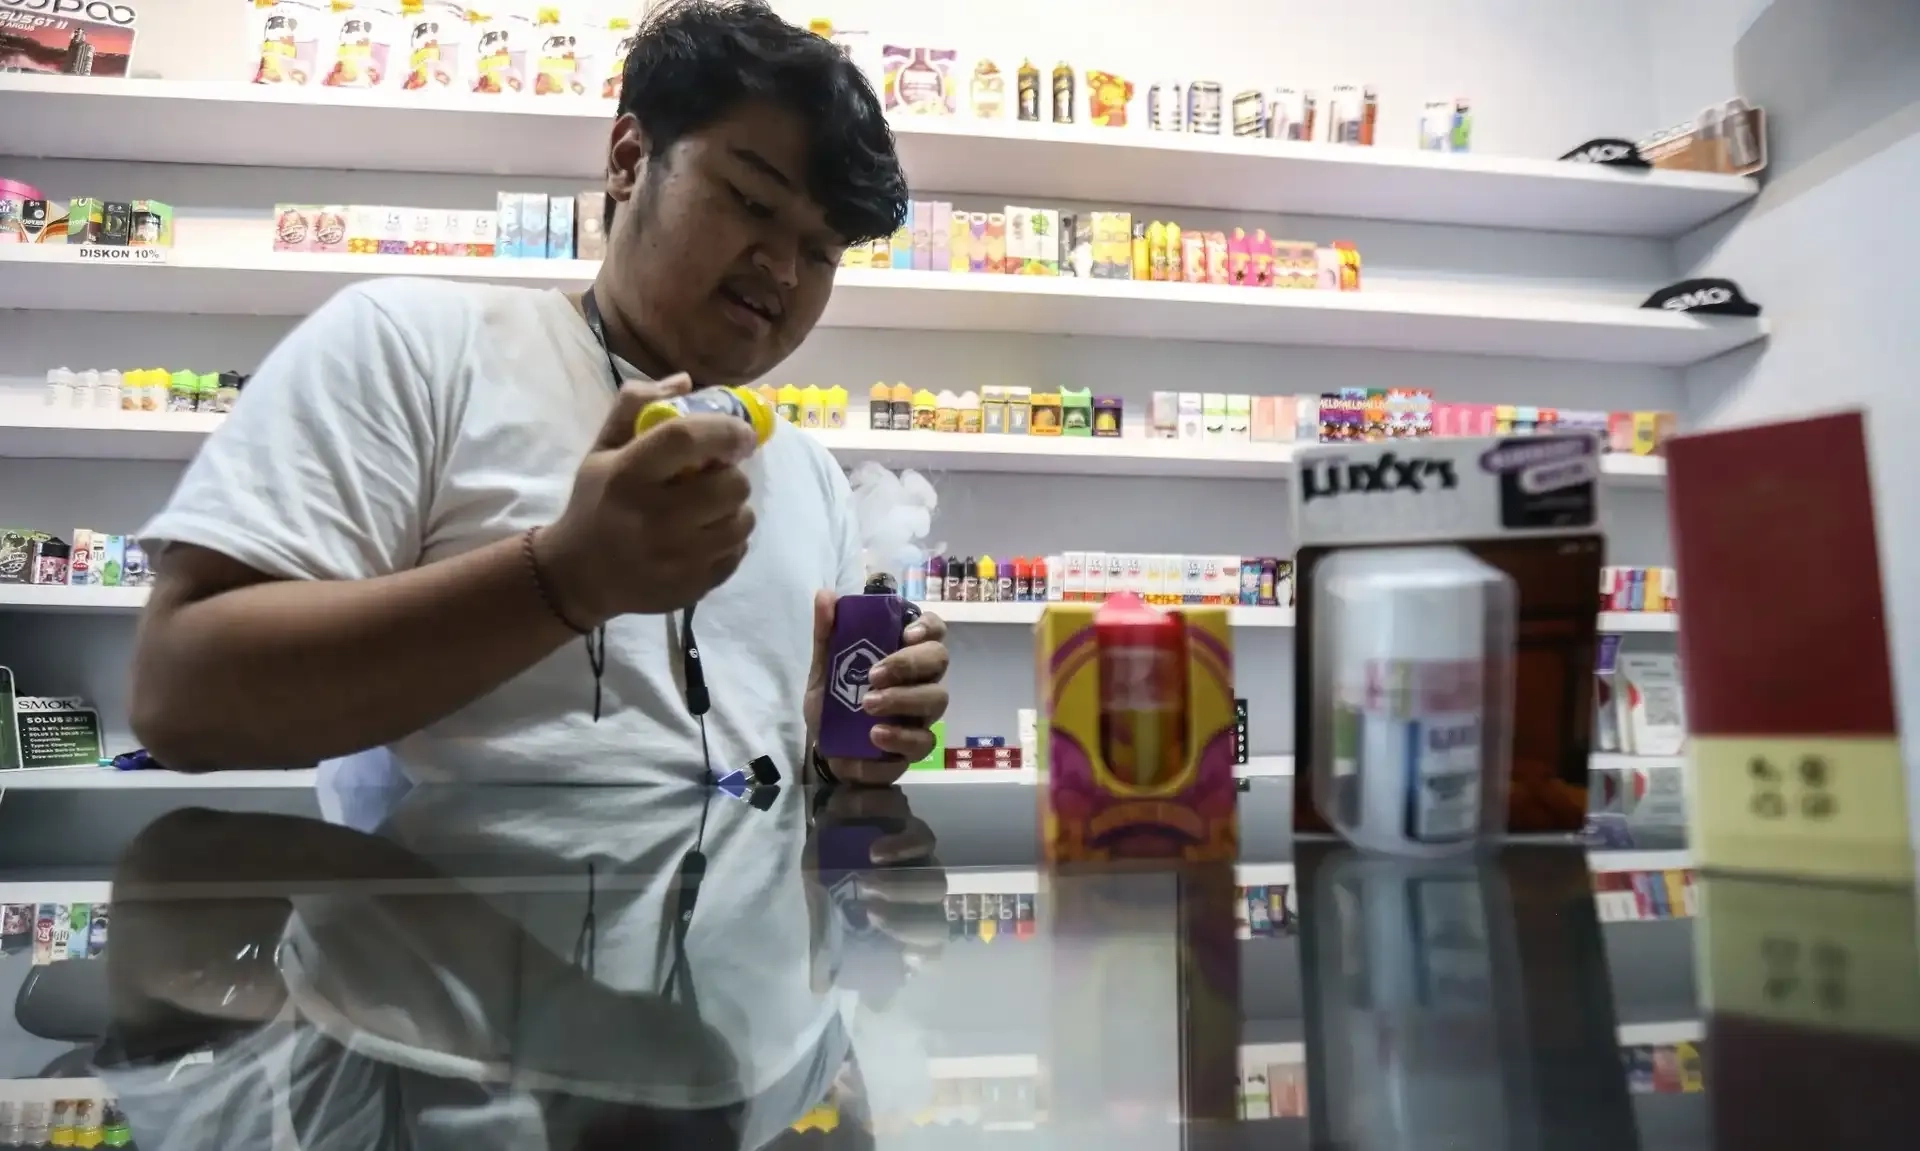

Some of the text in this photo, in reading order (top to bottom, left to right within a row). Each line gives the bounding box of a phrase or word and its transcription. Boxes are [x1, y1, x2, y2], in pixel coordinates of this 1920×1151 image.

[80, 248, 160, 259] DISKON 10%
[19, 700, 75, 710] SMOK
